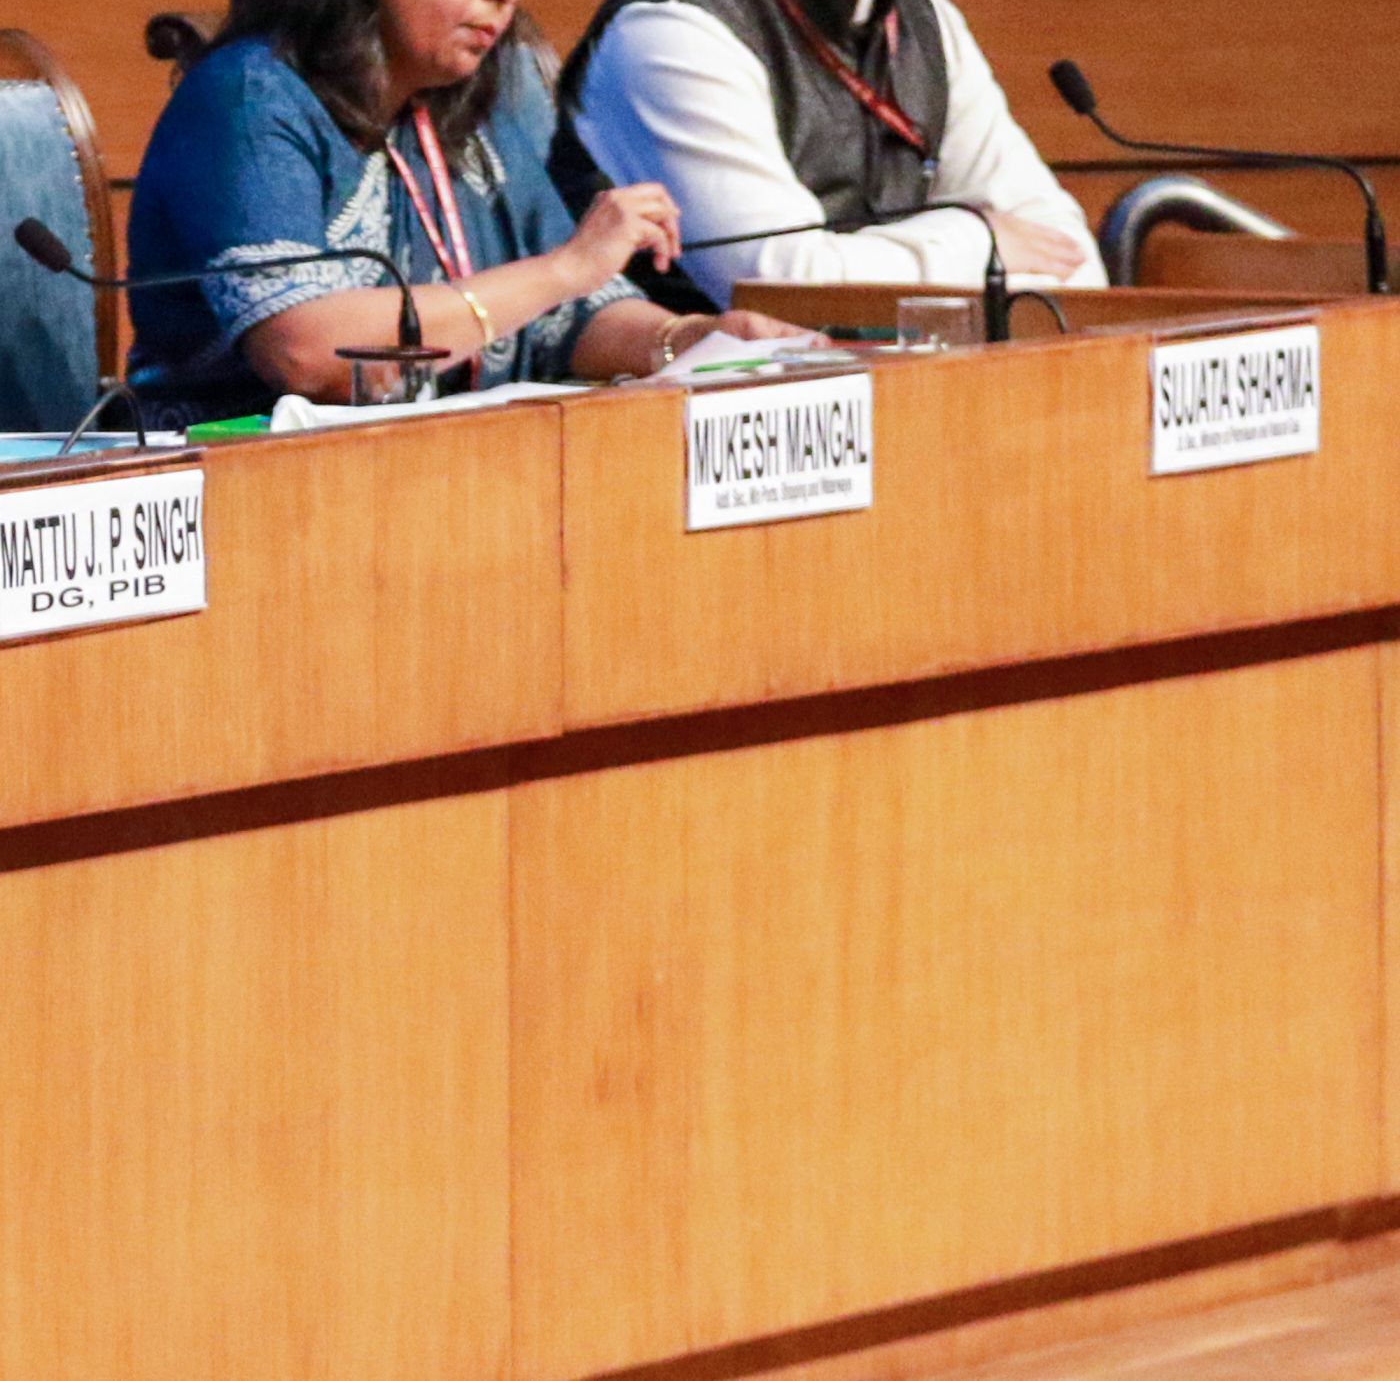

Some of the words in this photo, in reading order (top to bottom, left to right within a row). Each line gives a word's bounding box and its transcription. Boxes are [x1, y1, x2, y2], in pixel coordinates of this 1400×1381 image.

[1160, 357, 1231, 430] SUJATA
[1236, 345, 1314, 418] SHARMA
[694, 409, 779, 487] MUKESH
[786, 399, 867, 473] MANGAL
[0, 512, 77, 589] MATTU
[85, 510, 102, 578] J.
[109, 506, 126, 573] P.
[133, 495, 199, 570] SINGH
[31, 587, 94, 613] DG,
[109, 574, 166, 602] PIB
